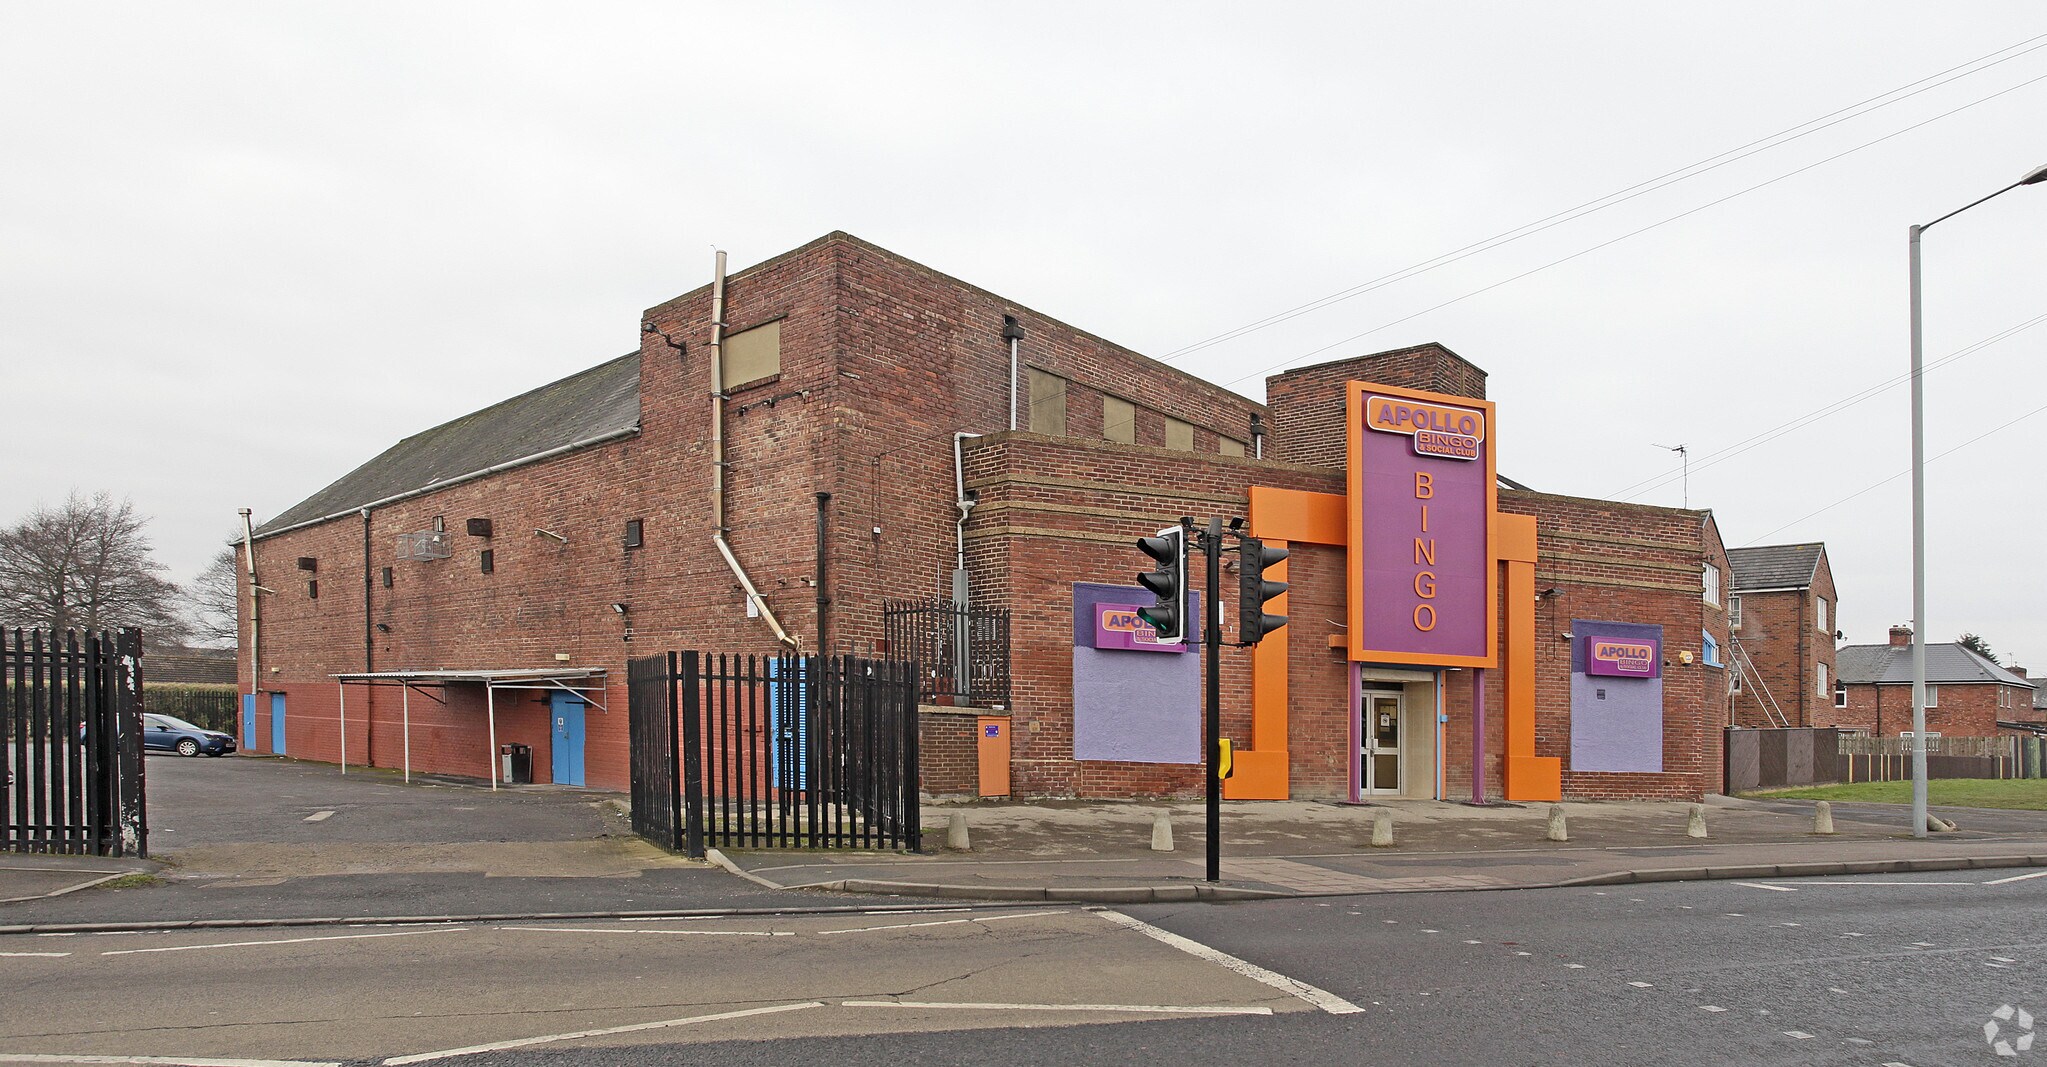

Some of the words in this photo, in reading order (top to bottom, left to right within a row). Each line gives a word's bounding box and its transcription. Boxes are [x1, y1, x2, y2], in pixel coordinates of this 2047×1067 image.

[1377, 404, 1476, 435] APOLLO
[1419, 432, 1476, 449] BINGO
[1419, 443, 1425, 451] &
[1426, 444, 1455, 455] SOCIAL
[1455, 447, 1476, 457] CLUB
[1413, 471, 1438, 632] BINGO
[1600, 646, 1648, 659] APOLLO
